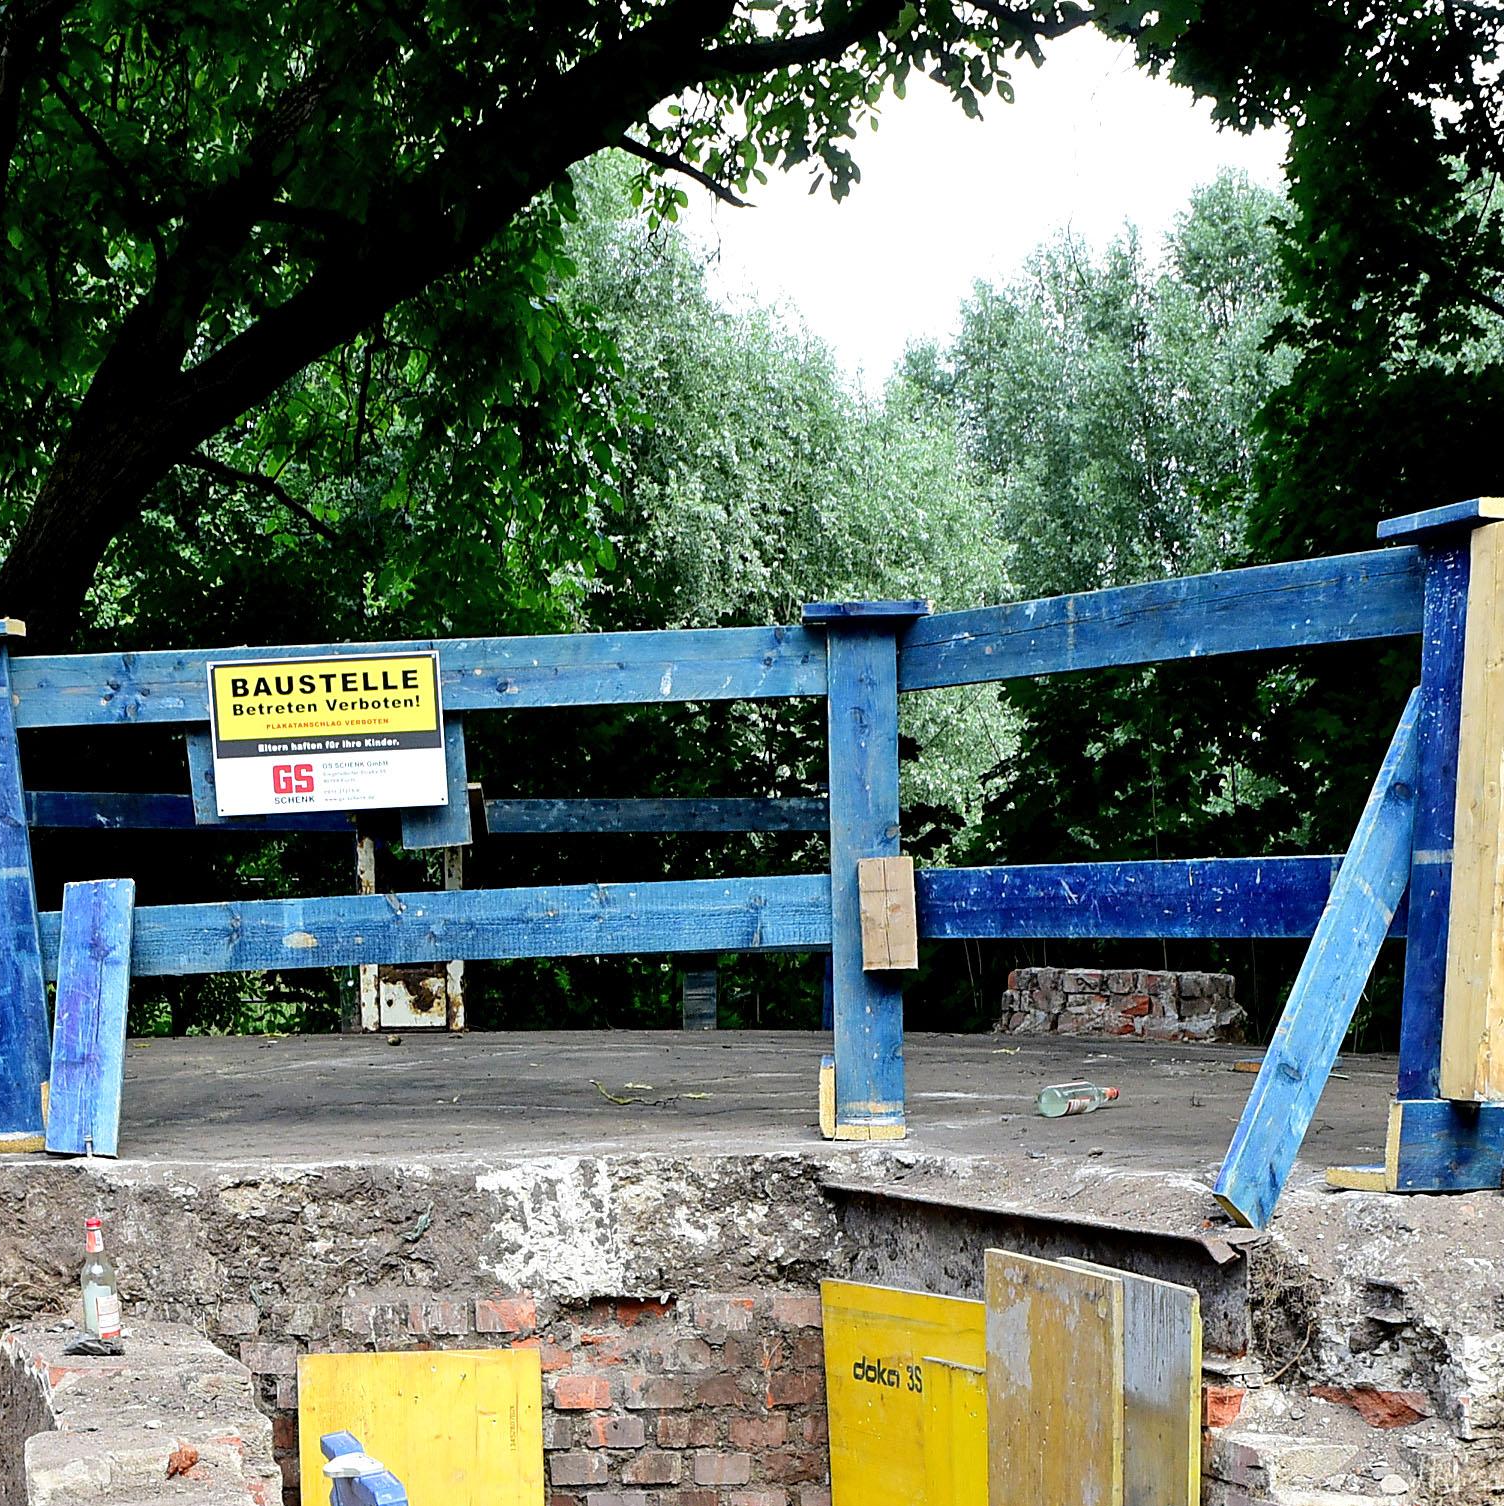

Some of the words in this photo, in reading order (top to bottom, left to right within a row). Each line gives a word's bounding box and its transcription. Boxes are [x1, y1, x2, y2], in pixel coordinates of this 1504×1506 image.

[231, 669, 419, 698] BAUSTELLE
[233, 701, 318, 716] Betreten
[326, 695, 421, 712] Verboten!
[344, 718, 389, 726] VERBOTEN
[257, 743, 289, 753] Eltern
[290, 741, 323, 751] haften
[325, 740, 340, 749] für
[342, 739, 362, 749] Ihre
[364, 737, 400, 747] Kinder.
[335, 761, 365, 769] SCHENK
[272, 763, 315, 794] GS
[274, 795, 315, 805] SCHENK
[852, 1355, 901, 1389] doka
[906, 1365, 923, 1394] 3S
